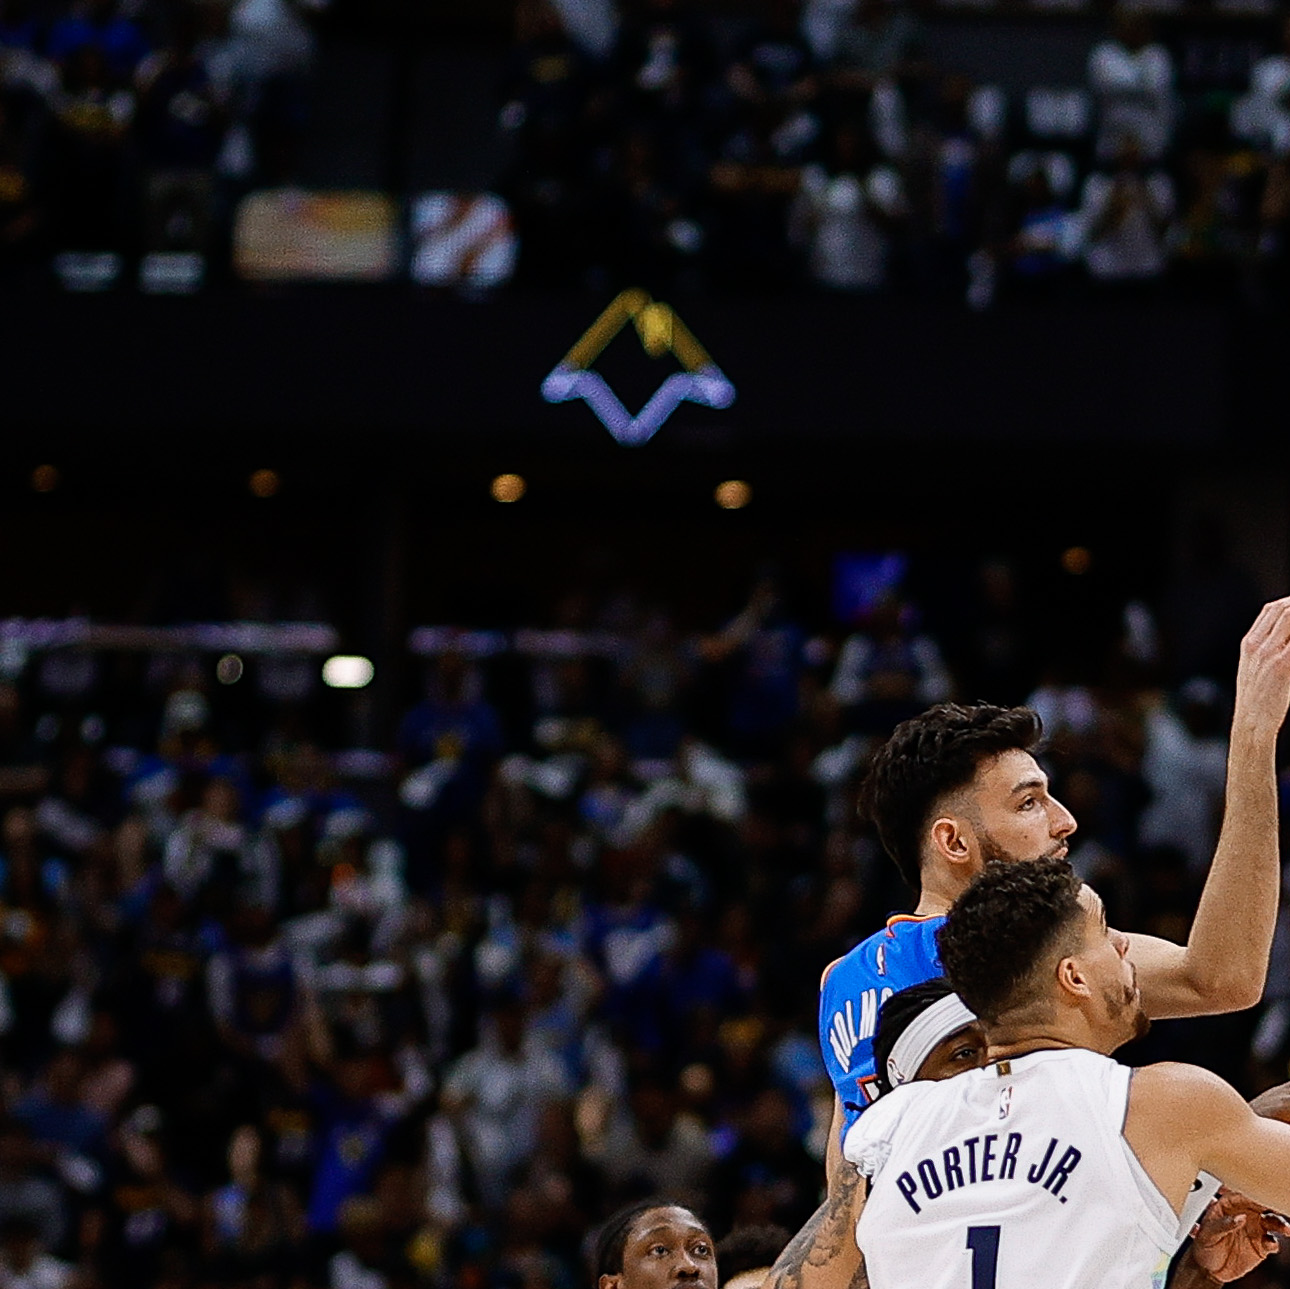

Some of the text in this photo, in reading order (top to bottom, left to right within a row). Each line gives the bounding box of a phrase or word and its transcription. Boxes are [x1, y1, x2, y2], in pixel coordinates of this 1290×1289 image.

[829, 986, 894, 1074] HOLM
[895, 1131, 1082, 1215] PORTER JR.
